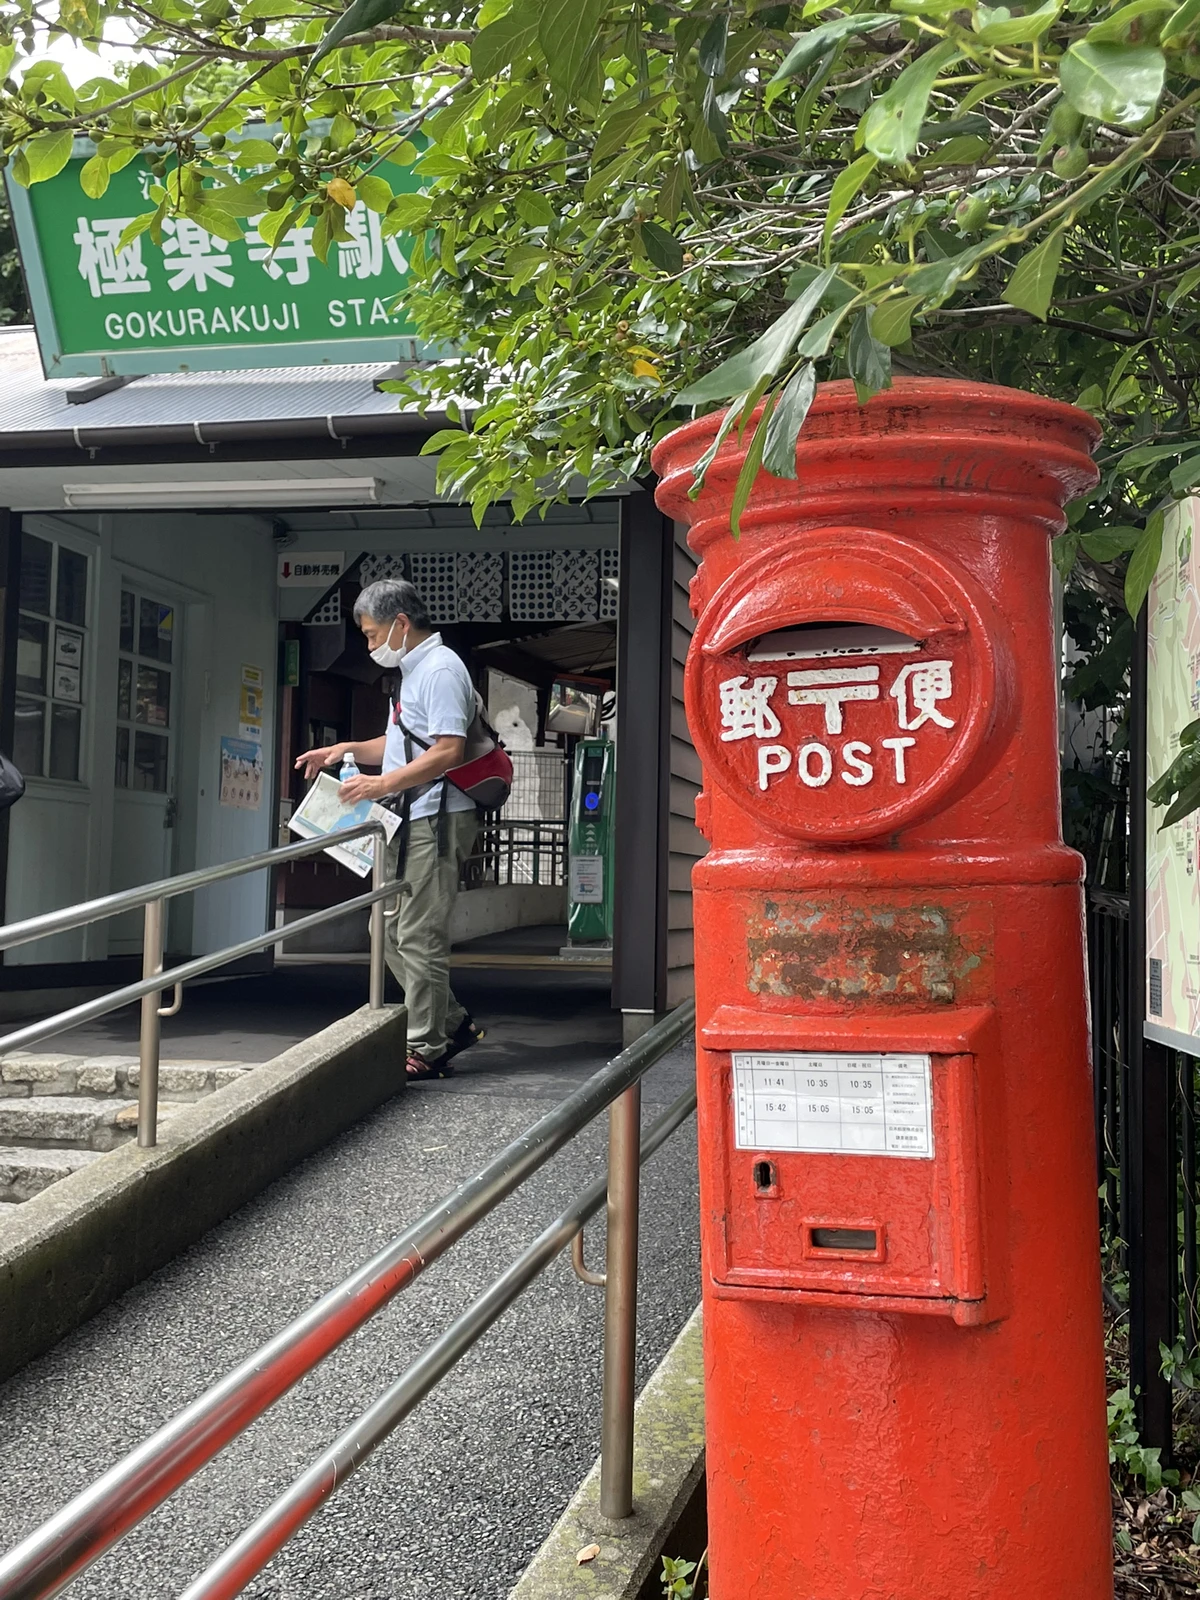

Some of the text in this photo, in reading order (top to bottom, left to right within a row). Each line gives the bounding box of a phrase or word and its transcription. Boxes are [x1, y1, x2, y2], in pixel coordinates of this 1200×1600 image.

[104, 297, 399, 340] GOKURAKUJI STA.
[294, 563, 340, 576] 自動券売機
[758, 737, 916, 791] POST
[764, 1078, 785, 1087] 11:41
[806, 1079, 829, 1088] 10:35
[850, 1080, 873, 1089] 10:35
[765, 1103, 787, 1112] 15:42
[808, 1104, 830, 1113] 15:05
[852, 1106, 874, 1115] 15:05
